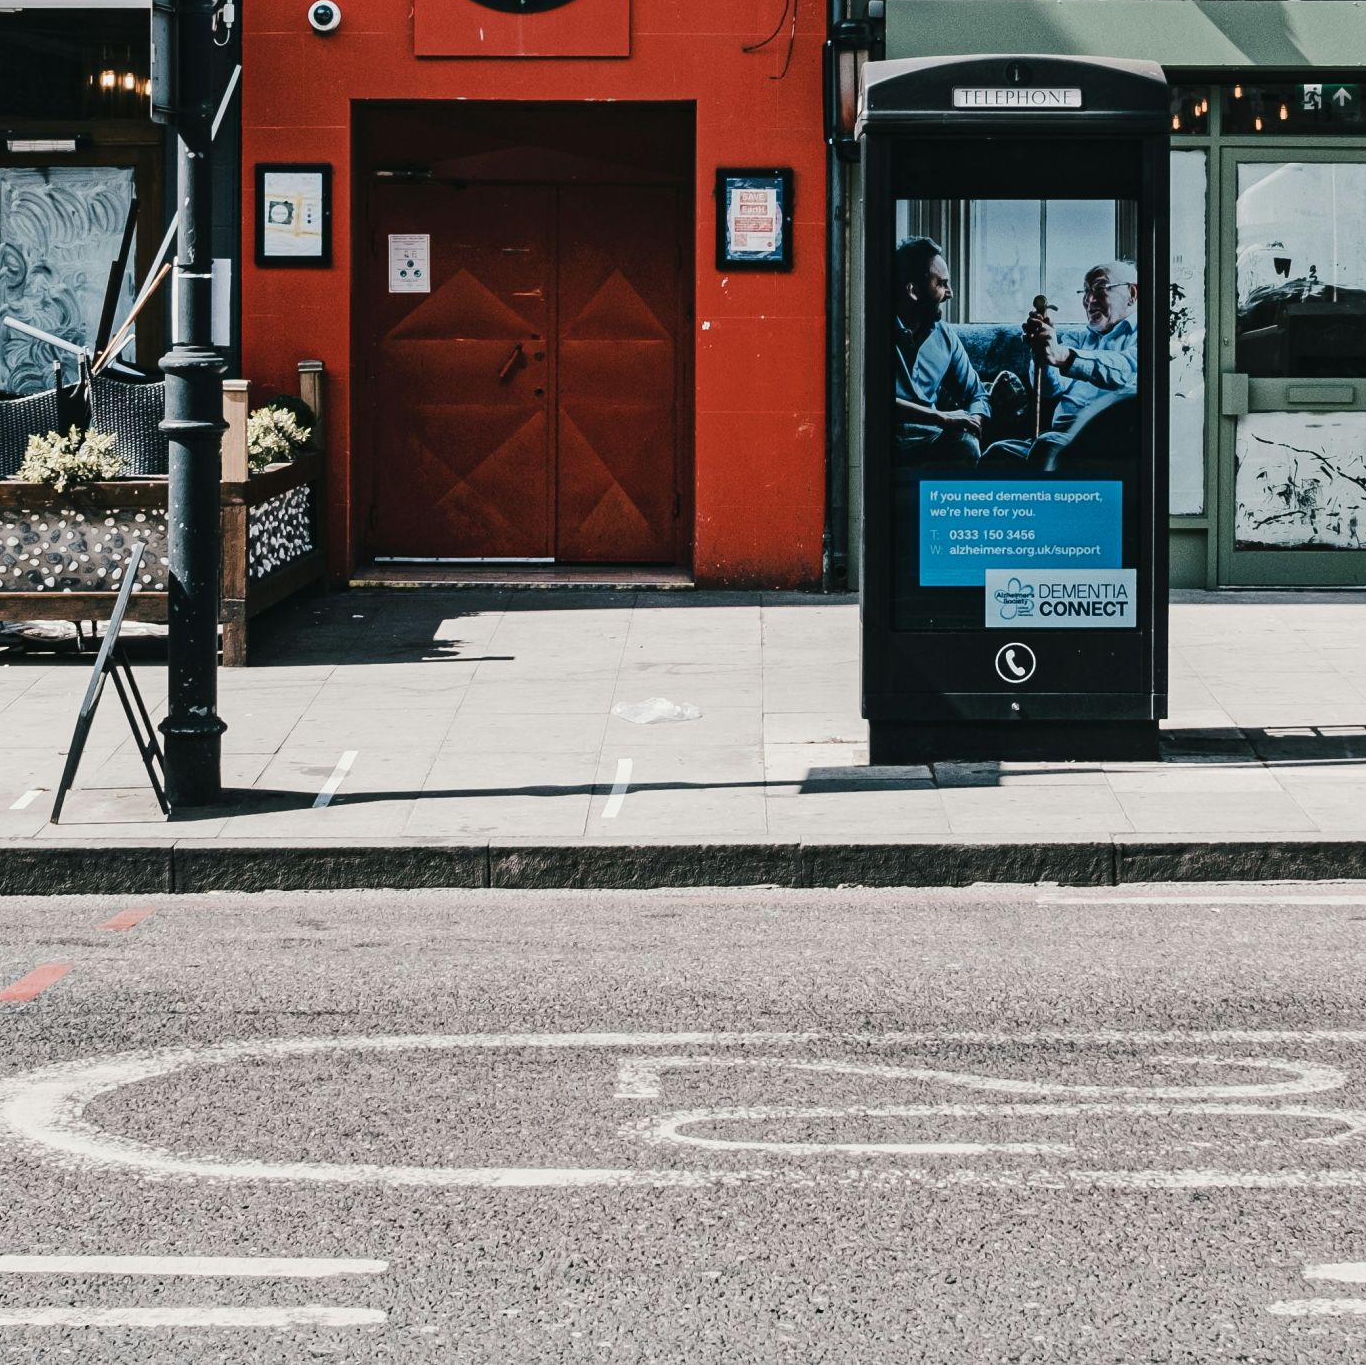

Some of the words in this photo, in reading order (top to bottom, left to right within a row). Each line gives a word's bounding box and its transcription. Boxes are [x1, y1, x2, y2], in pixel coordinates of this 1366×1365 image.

[961, 90, 1072, 105] TELEPHONE
[930, 491, 939, 502] If
[941, 493, 962, 504] you
[964, 491, 994, 502] need
[996, 491, 1052, 502] dementia
[1054, 492, 1103, 504] support,
[930, 507, 961, 517] we're
[963, 507, 990, 517] here
[993, 507, 1008, 517] for
[1012, 508, 1035, 519] you.
[949, 530, 979, 540] 0333
[983, 530, 1004, 540] 150
[1006, 530, 1035, 540] 3456
[949, 544, 1101, 557] alzheimers.org.uk/support
[1038, 584, 1128, 599] DEMENTIA
[1039, 600, 1129, 617] CONNECT
